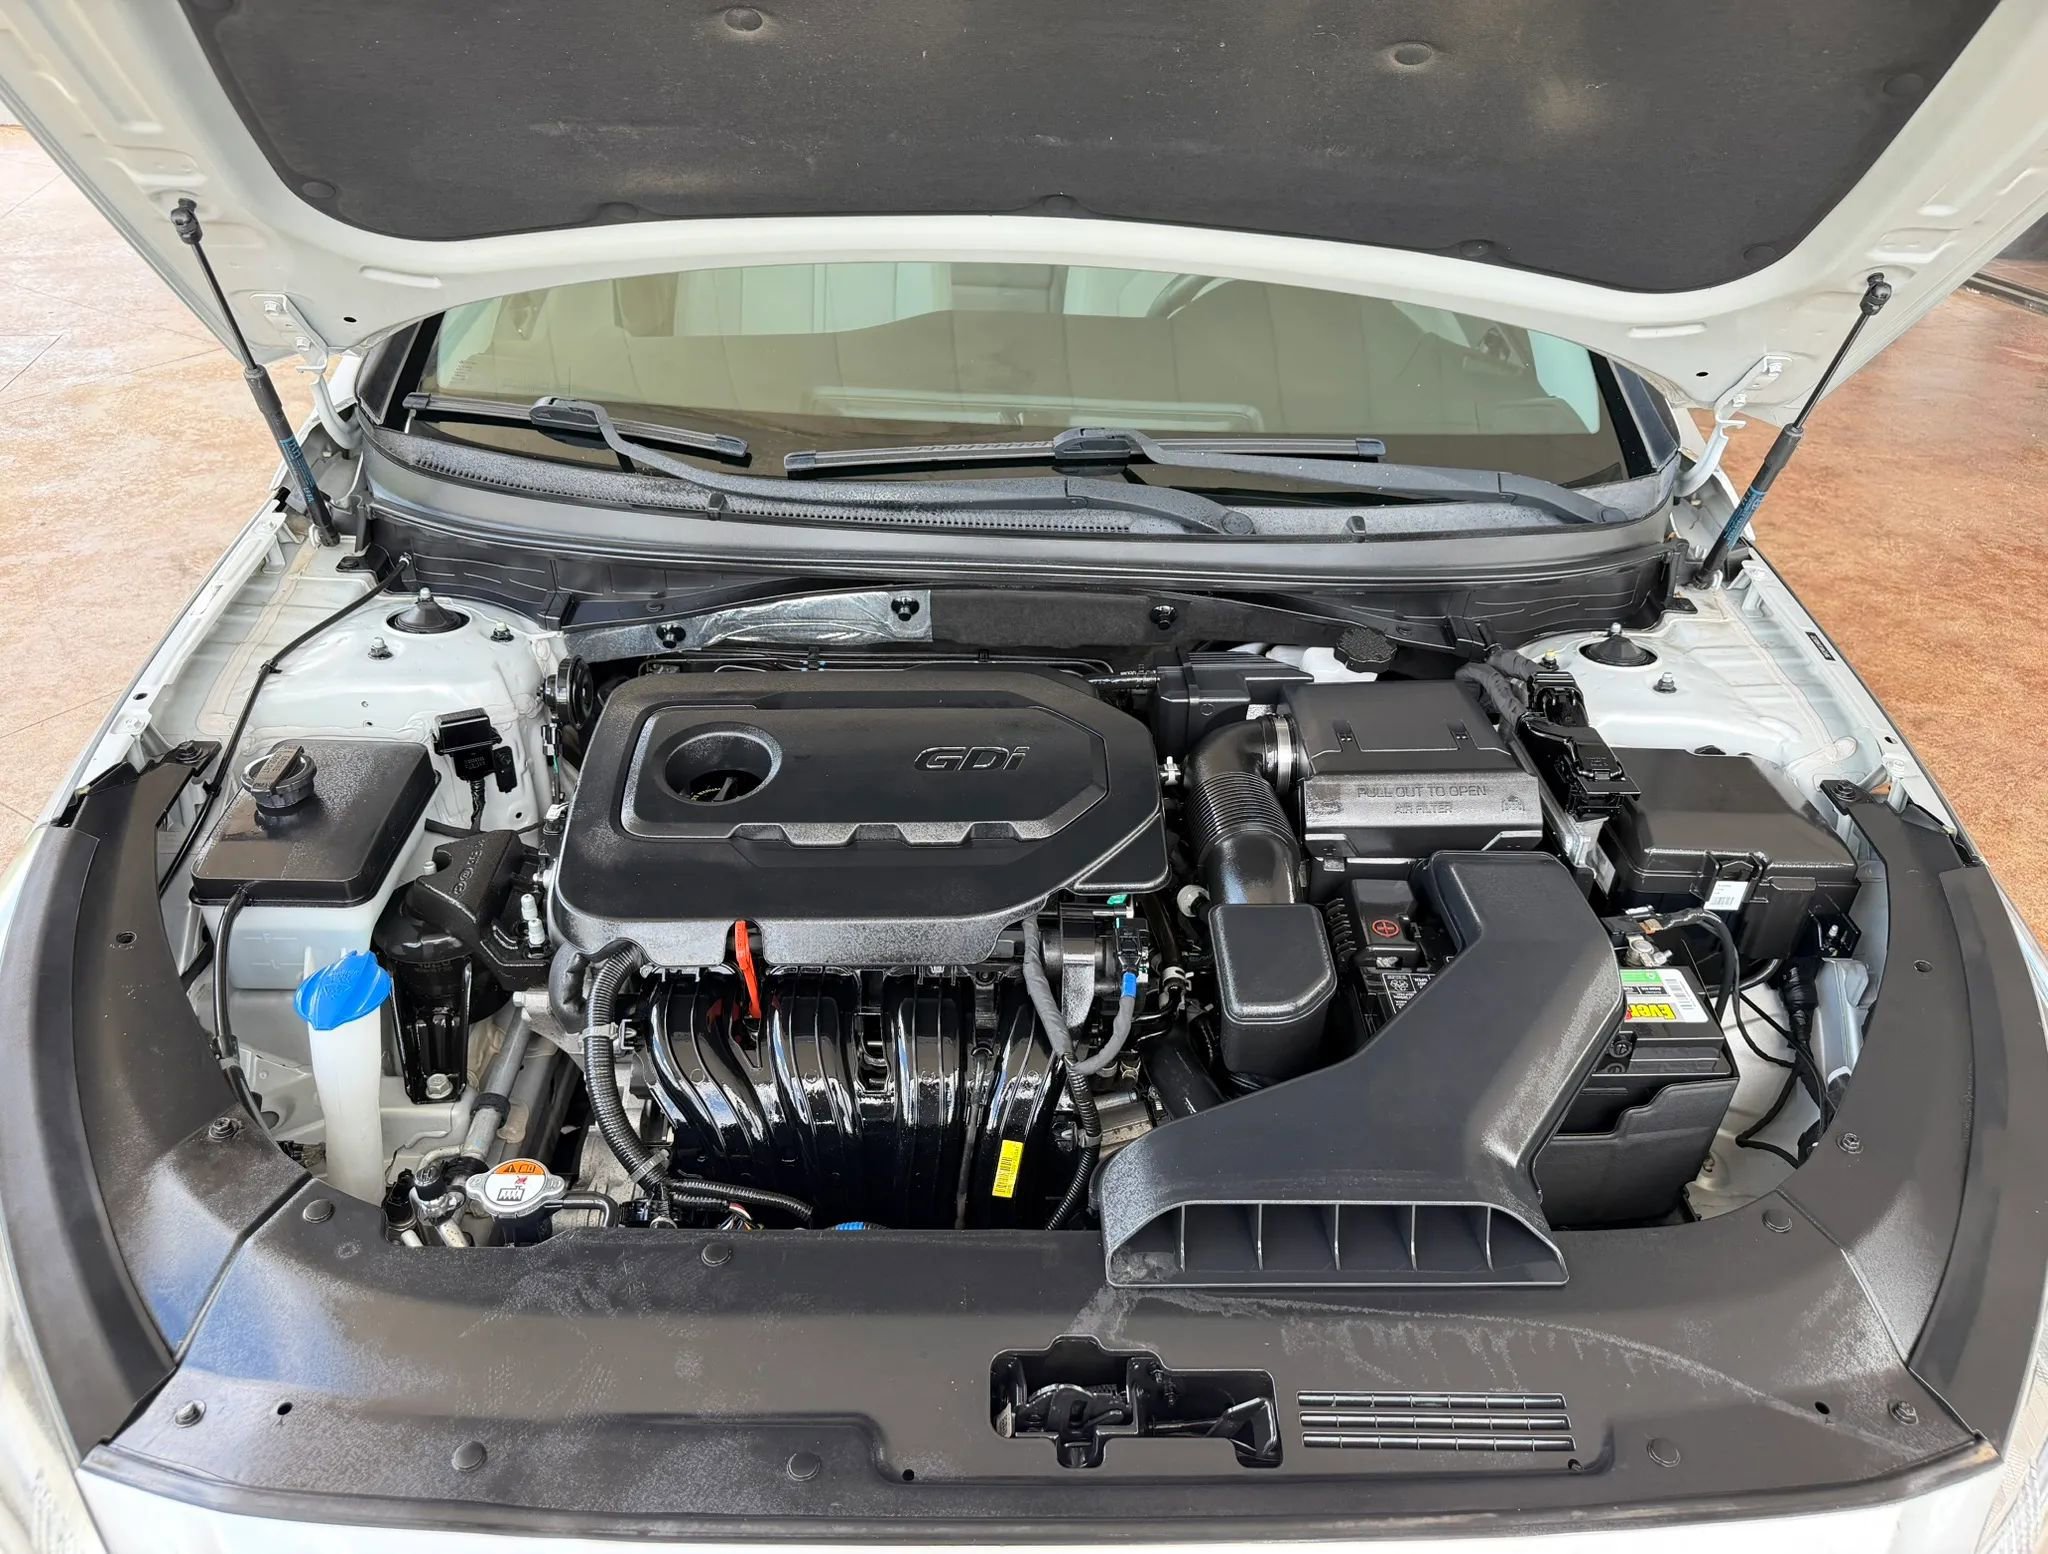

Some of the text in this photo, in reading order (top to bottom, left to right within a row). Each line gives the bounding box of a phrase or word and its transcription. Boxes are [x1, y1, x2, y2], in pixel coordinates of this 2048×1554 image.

[914, 746, 1030, 771] GDi
[1357, 784, 1487, 798] PULL OUT TO OPEN
[1394, 801, 1453, 814] AIR FILTER
[1626, 1002, 1677, 1021] Ever
